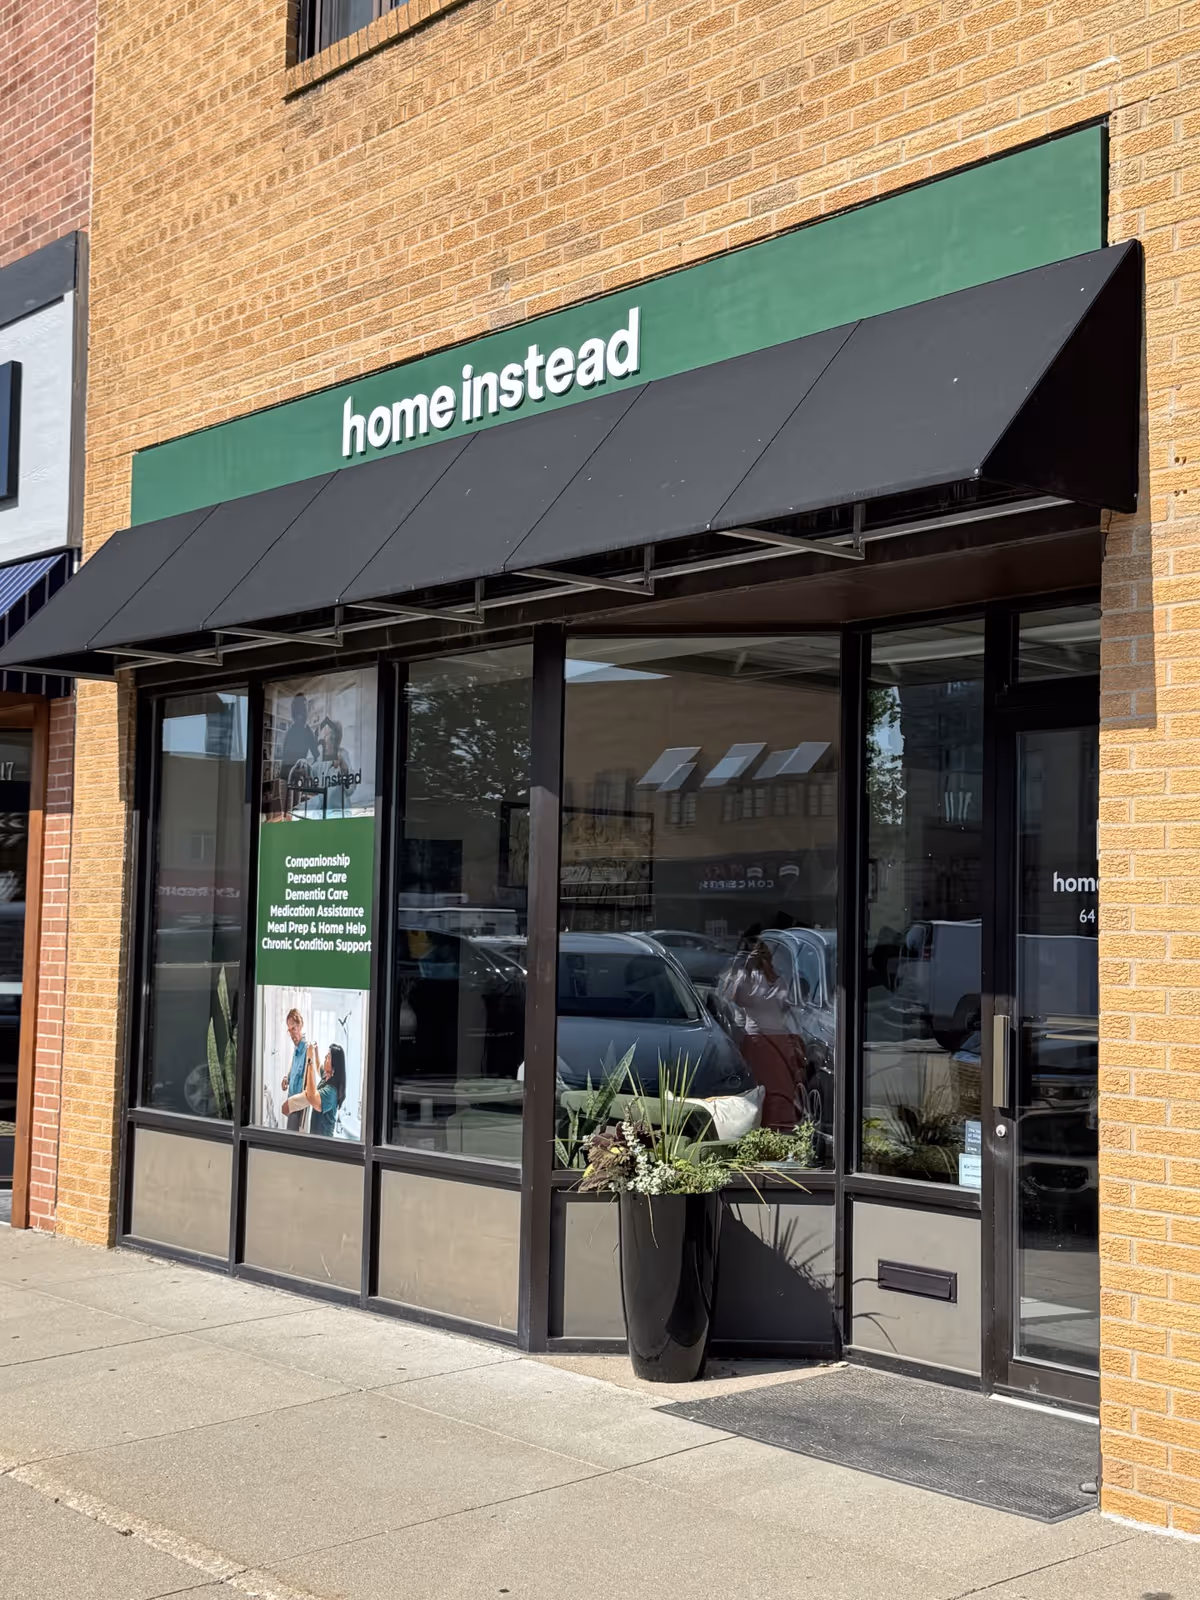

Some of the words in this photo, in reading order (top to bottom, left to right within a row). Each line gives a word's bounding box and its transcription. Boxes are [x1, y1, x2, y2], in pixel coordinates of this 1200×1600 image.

[342, 385, 457, 457] home
[462, 306, 642, 423] instead
[321, 768, 362, 788] instead
[285, 853, 350, 870] Companionship
[287, 872, 325, 884] Personal
[326, 871, 347, 884] Care
[285, 888, 326, 900] Dementia
[327, 888, 349, 900] Care
[270, 904, 315, 917] Medication
[316, 905, 364, 917] Assistance
[1079, 909, 1096, 923] 64
[267, 921, 287, 934] Meal
[288, 921, 309, 935] Prep
[310, 922, 317, 934] &
[318, 922, 344, 934] Home
[345, 922, 367, 936] Help
[262, 937, 292, 950] Chronic
[293, 938, 334, 951] Condition
[335, 939, 372, 953] Support
